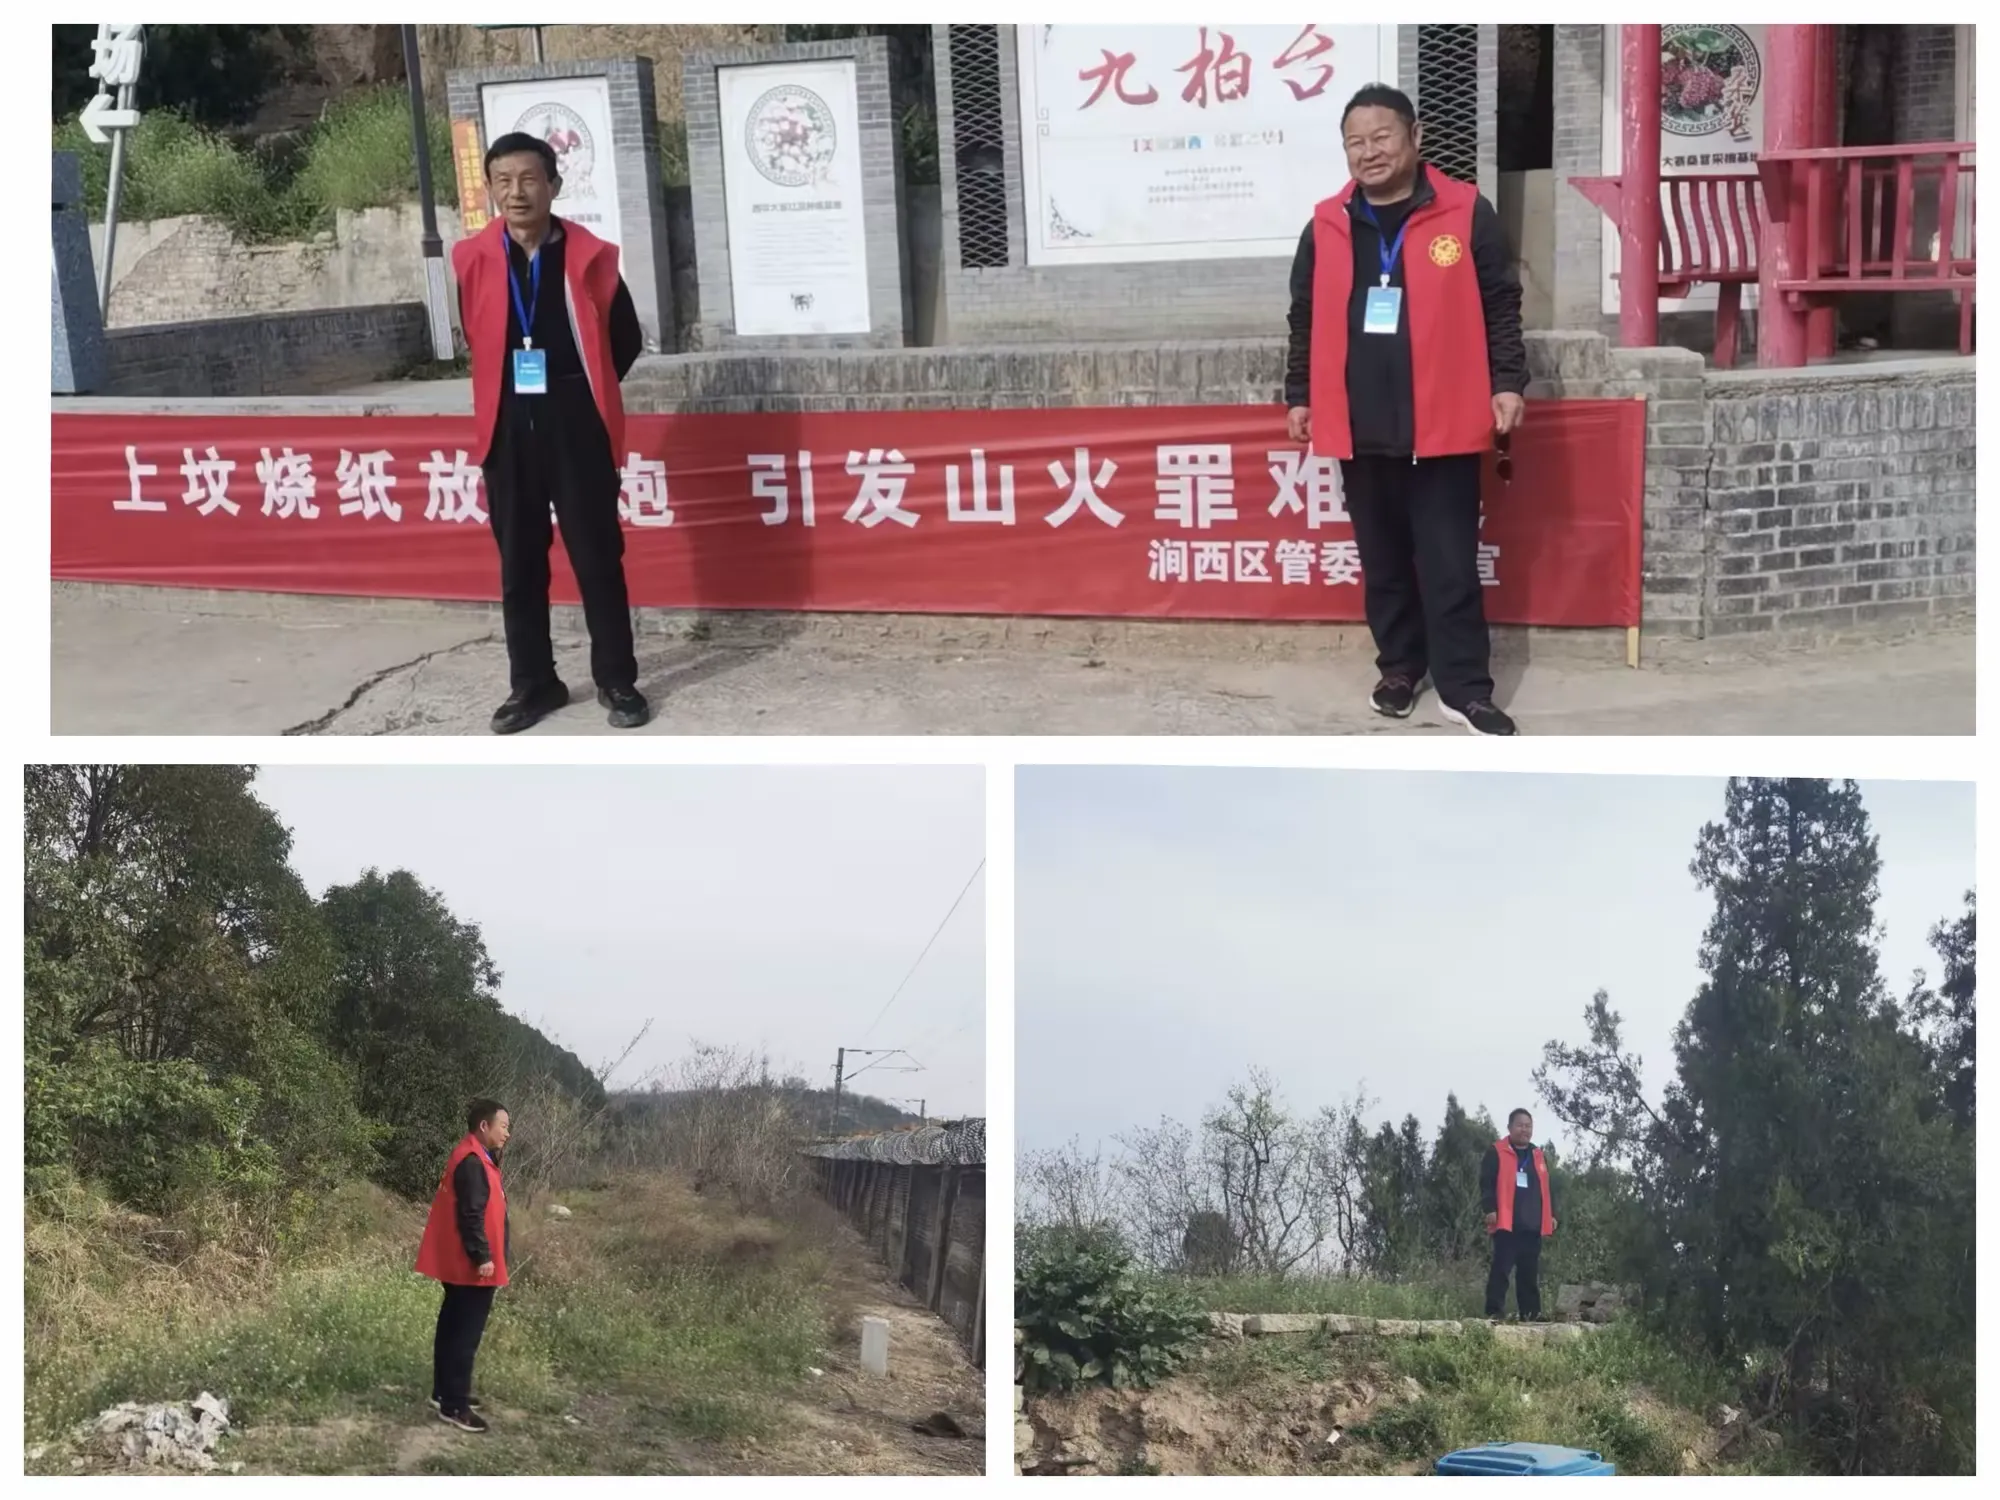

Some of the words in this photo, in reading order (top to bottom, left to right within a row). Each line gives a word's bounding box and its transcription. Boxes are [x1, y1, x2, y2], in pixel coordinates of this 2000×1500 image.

[112, 445, 675, 527] 上坟烧纸放炮
[747, 443, 1487, 529] 引发山火罪难
